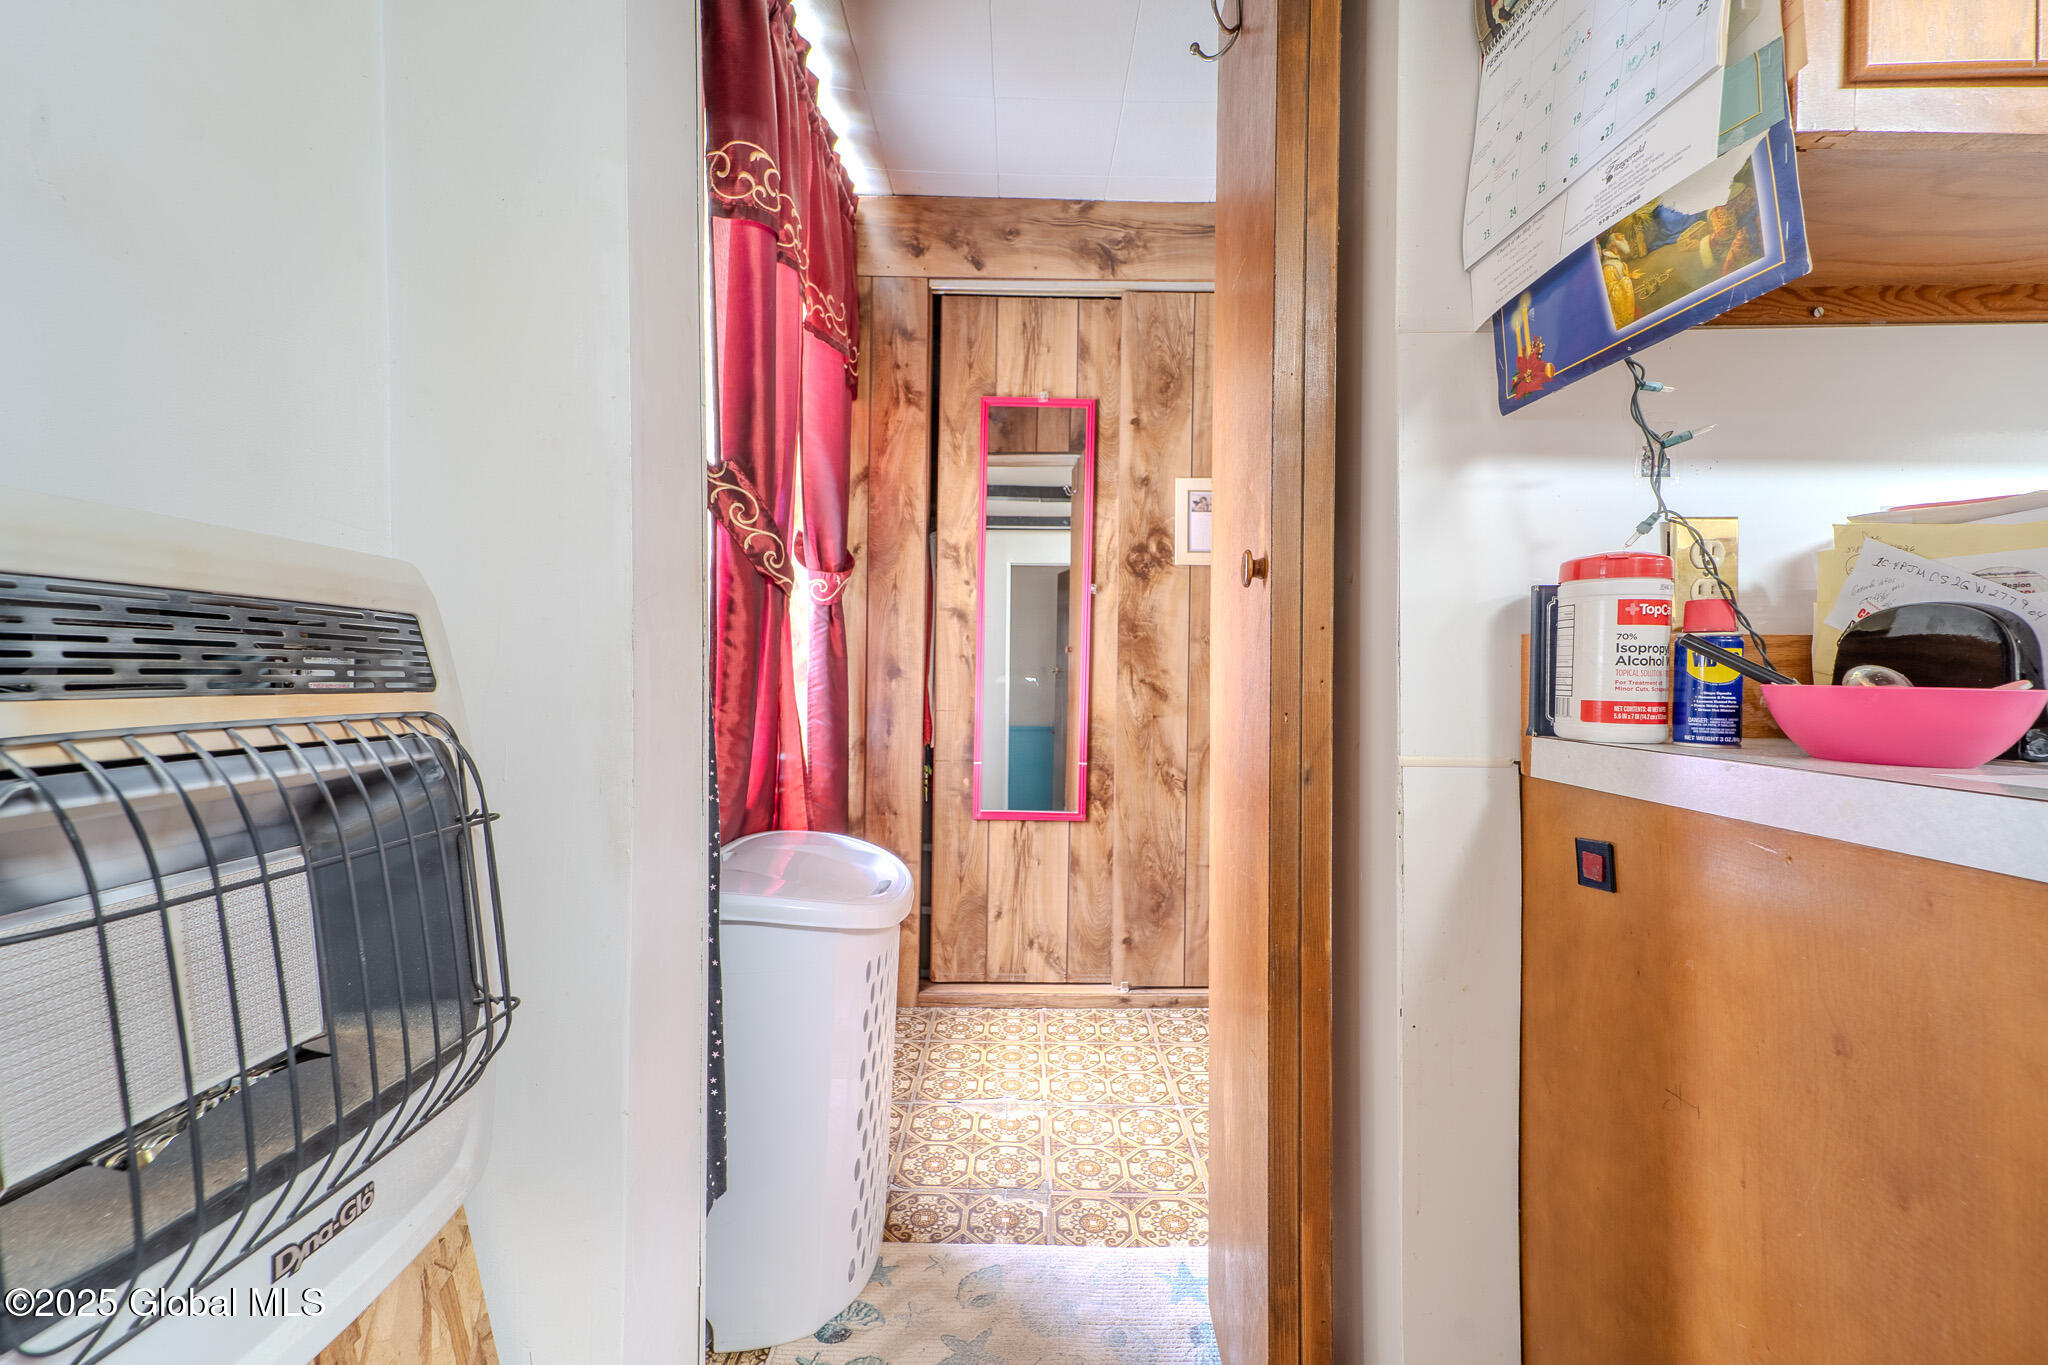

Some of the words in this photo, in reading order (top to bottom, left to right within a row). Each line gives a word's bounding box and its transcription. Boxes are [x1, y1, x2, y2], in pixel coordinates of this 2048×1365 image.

[1696, 0, 1709, 16] 22
[1586, 27, 1592, 40] 5
[1616, 34, 1624, 48] 13
[1650, 41, 1660, 58] 21
[1578, 70, 1586, 84] 12
[1609, 78, 1618, 94] 20
[1645, 88, 1656, 104] 28
[1545, 103, 1552, 115] 11
[1573, 112, 1581, 125] 19
[1496, 122, 1500, 132] 2
[1605, 122, 1614, 138] 27
[1516, 131, 1522, 143] 10
[1541, 142, 1548, 154] 18
[1570, 153, 1578, 168] 26
[1512, 168, 1518, 180] 17
[1538, 181, 1545, 194] 25
[1486, 192, 1491, 204] 16
[1510, 206, 1516, 219] 24
[1483, 228, 1490, 240] 23
[1615, 656, 1665, 666] Alcohol
